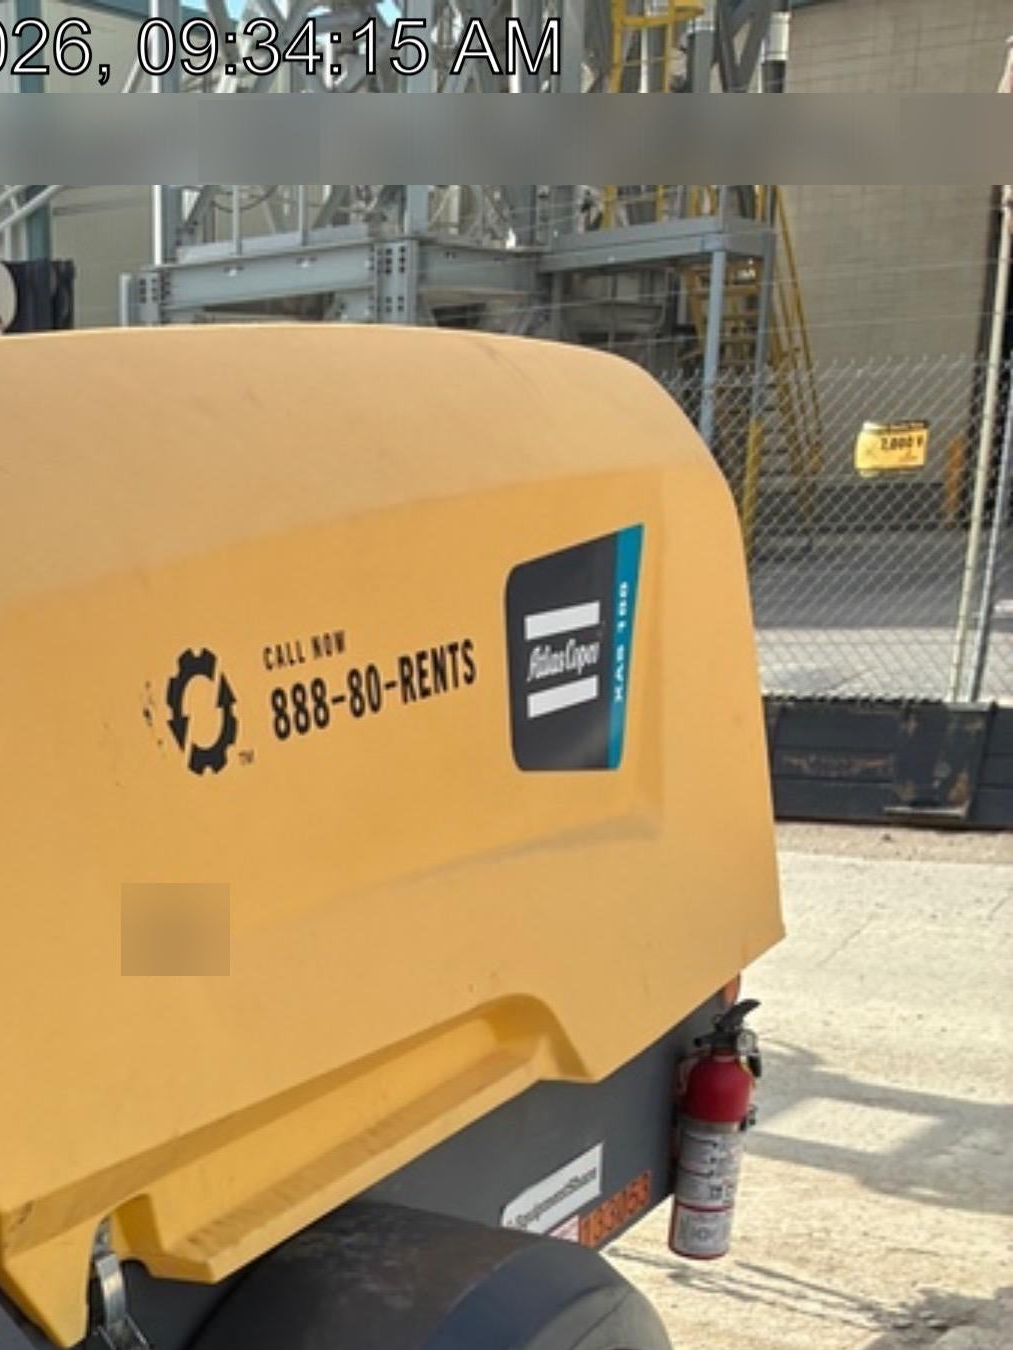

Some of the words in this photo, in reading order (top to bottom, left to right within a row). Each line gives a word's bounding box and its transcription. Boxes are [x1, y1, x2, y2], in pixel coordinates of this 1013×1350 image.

[263, 640, 306, 671] CALL
[311, 629, 346, 660] NOW
[271, 638, 477, 741] 888-80-RENTS
